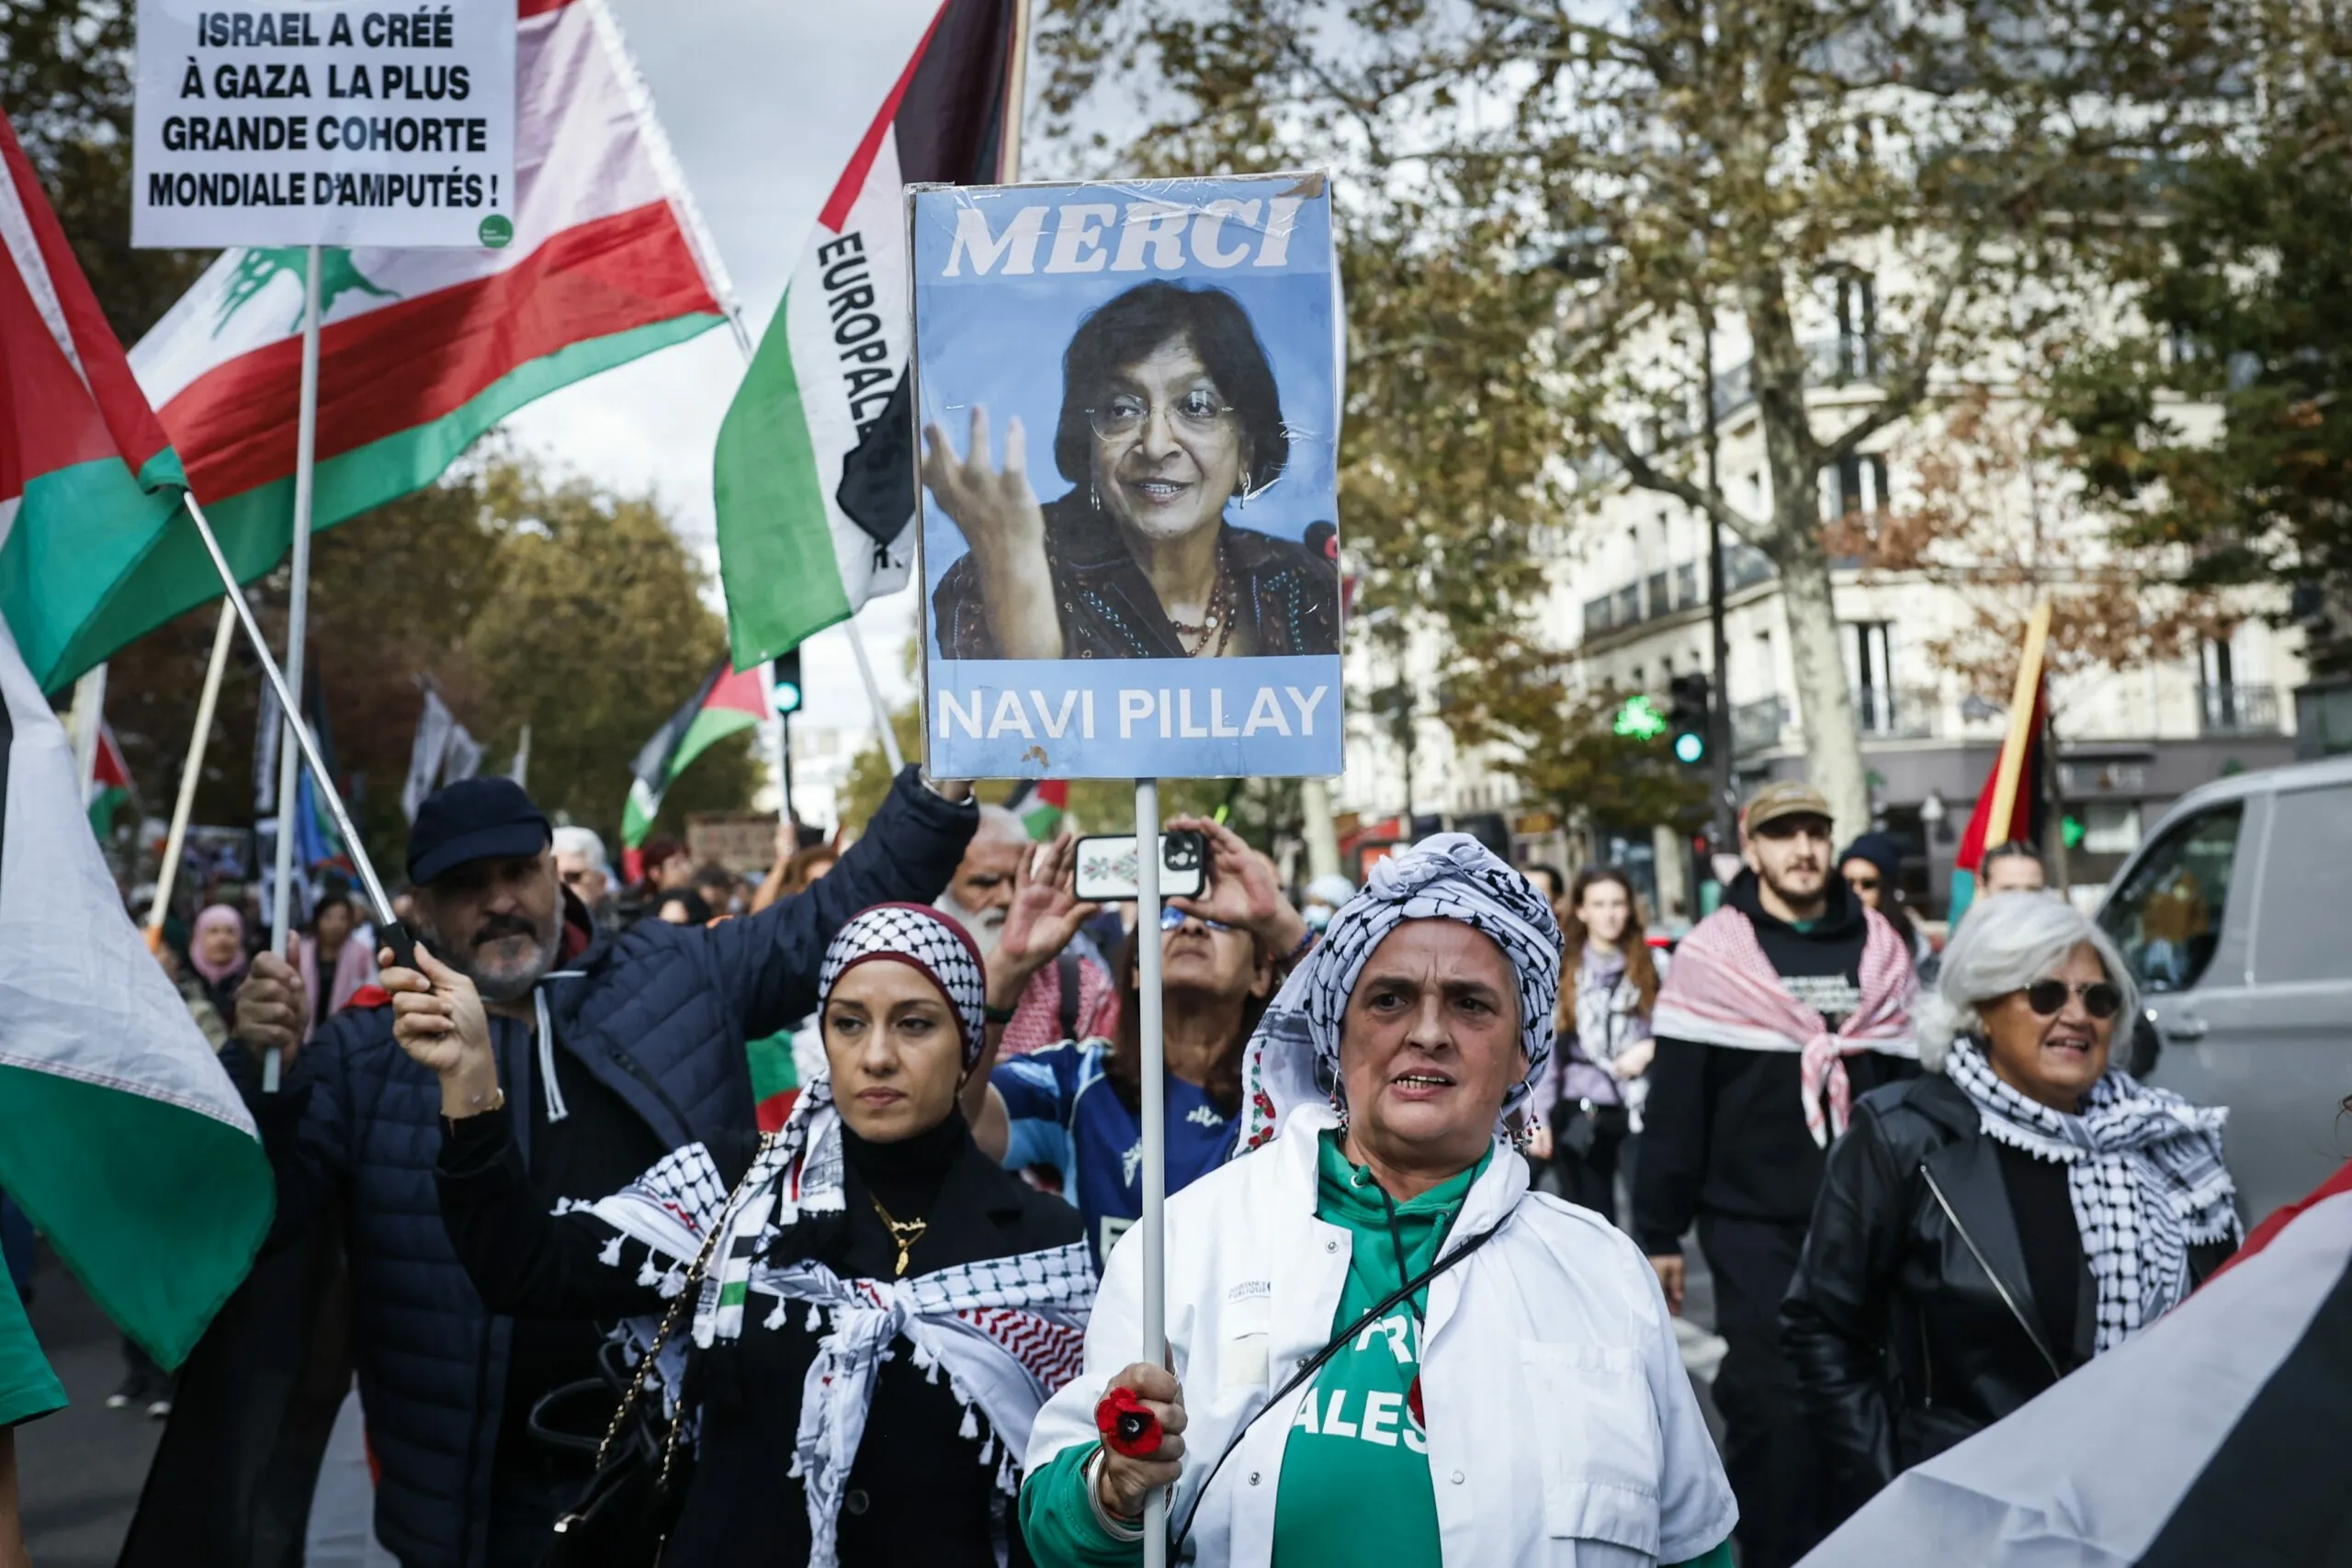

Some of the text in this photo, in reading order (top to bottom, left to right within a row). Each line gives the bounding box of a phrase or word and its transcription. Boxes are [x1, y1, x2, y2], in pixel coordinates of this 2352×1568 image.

[198, 6, 454, 49] ISRAEL A CRÉÉ
[180, 56, 471, 101] À GAZA LA PLUS
[162, 116, 487, 152] GRANDE COHORTE
[148, 172, 306, 208] MONDIALE
[312, 165, 483, 209] D'AMPUTÉS
[942, 197, 1304, 277] MERCI
[817, 231, 897, 446] EUROPAL
[938, 685, 1329, 739] NAVI PILLAY
